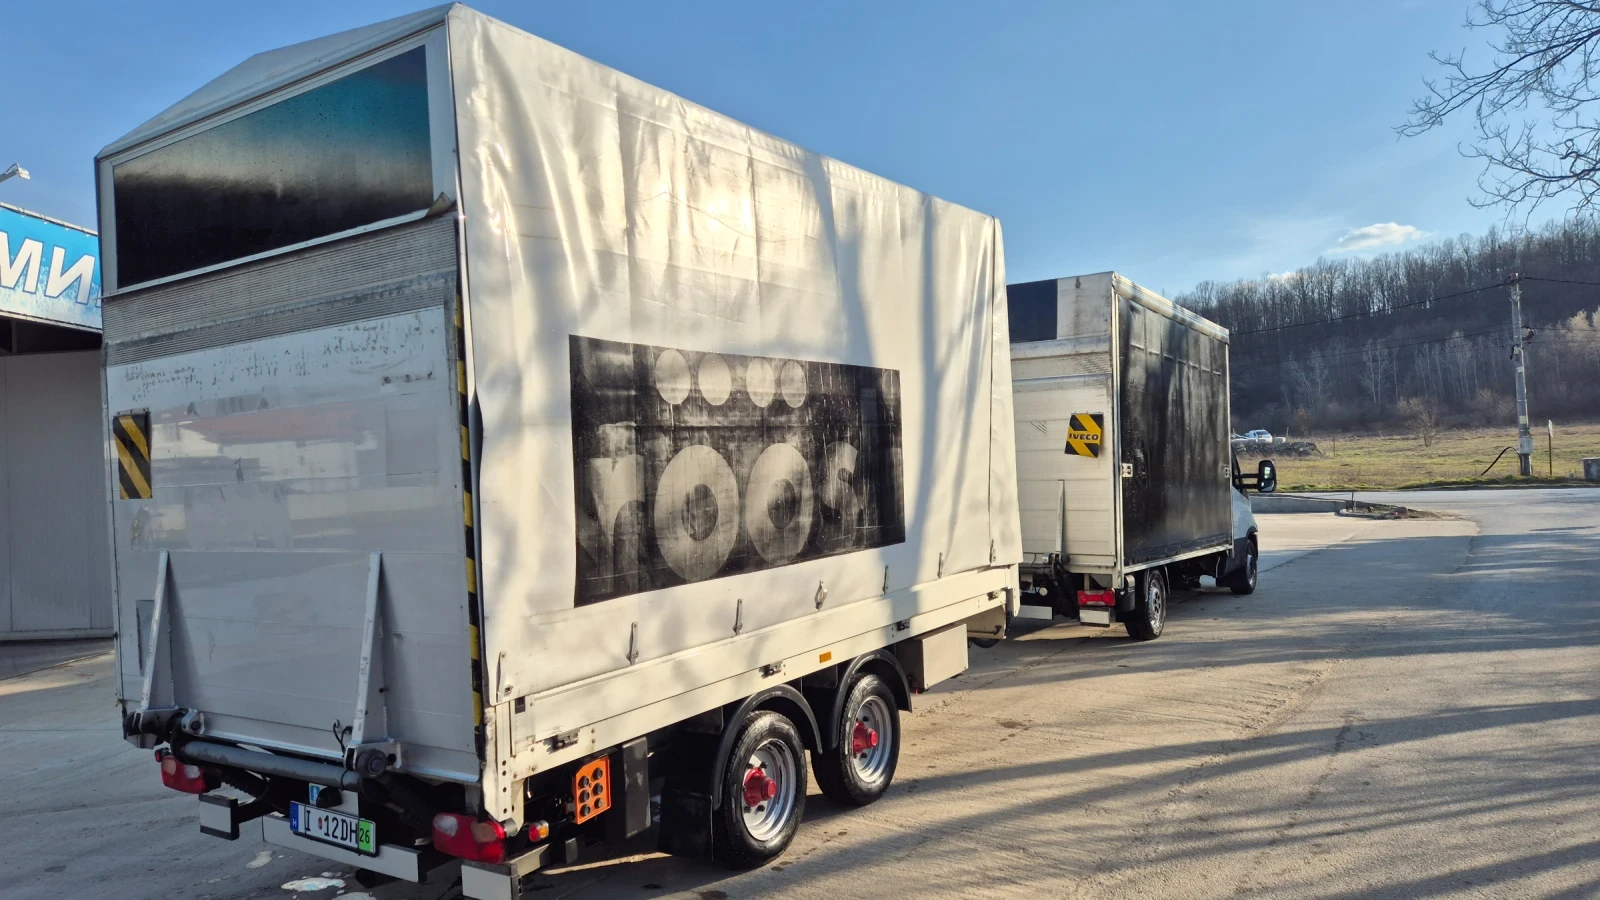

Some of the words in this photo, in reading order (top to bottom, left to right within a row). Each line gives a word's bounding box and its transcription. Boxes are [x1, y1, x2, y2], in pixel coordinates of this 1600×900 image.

[0, 230, 102, 309] МИ
[1068, 432, 1099, 441] IVECO
[292, 818, 297, 827] H
[359, 828, 371, 844] 26
